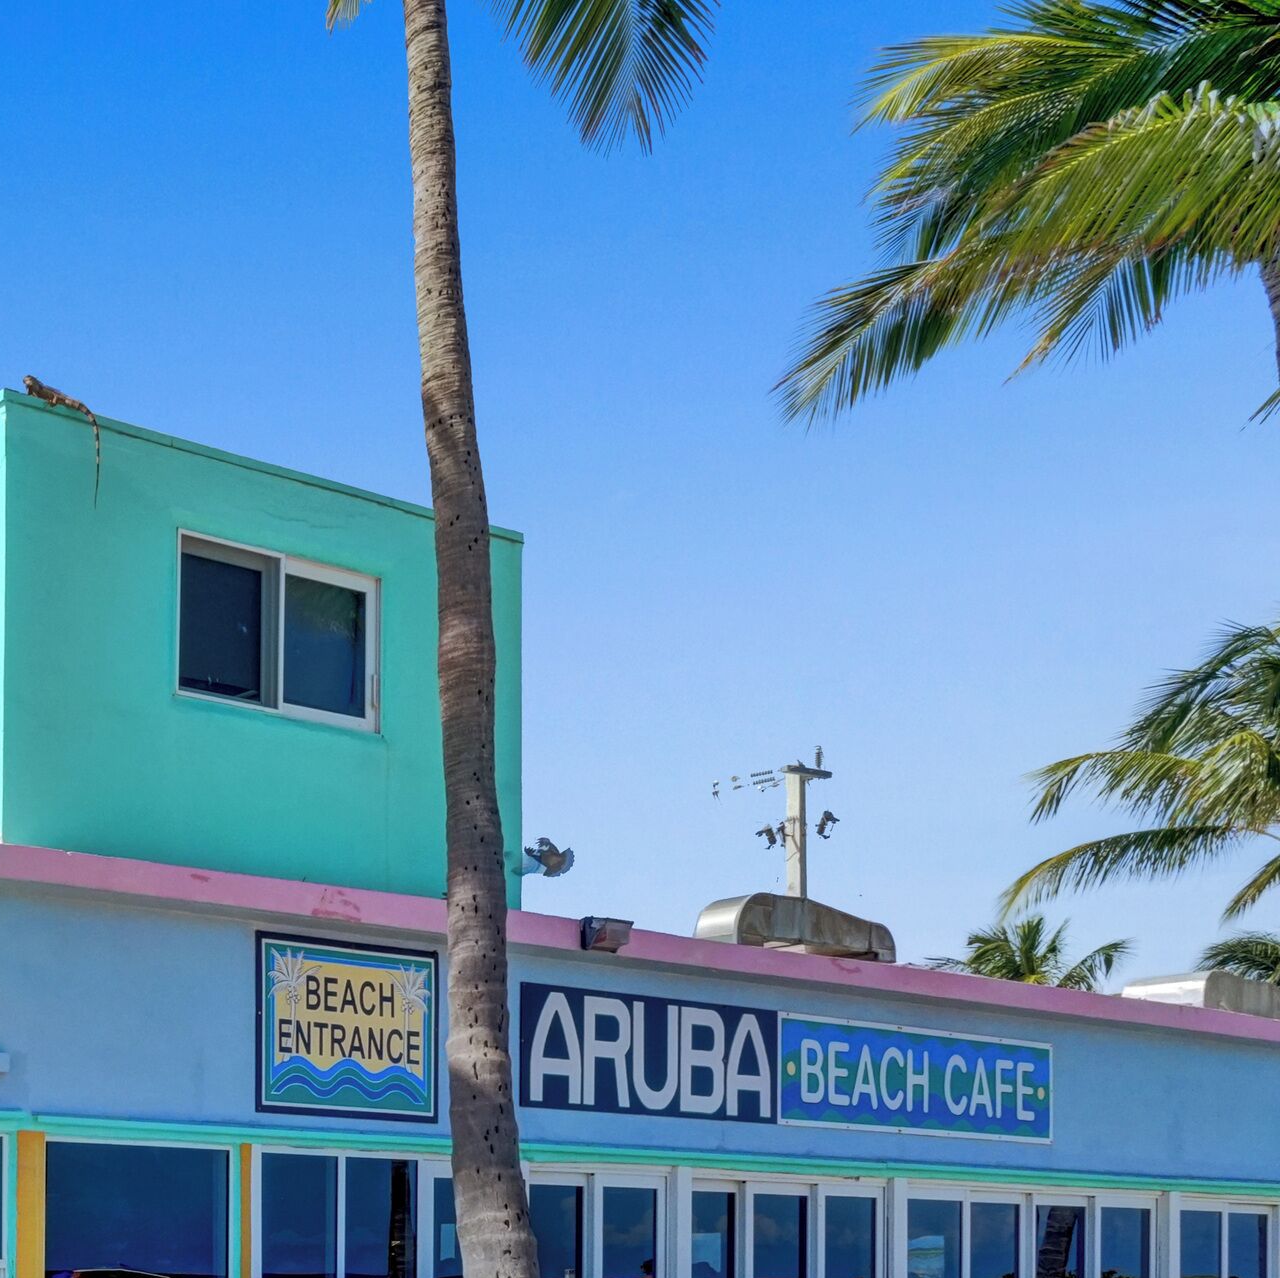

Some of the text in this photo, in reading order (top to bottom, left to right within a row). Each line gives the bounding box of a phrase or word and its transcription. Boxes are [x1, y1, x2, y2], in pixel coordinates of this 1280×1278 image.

[305, 974, 396, 1019] BEACH
[278, 1018, 421, 1066] ENTRANCE
[529, 991, 772, 1118] ARUBA
[800, 1038, 1036, 1122] BEACH CAFE
